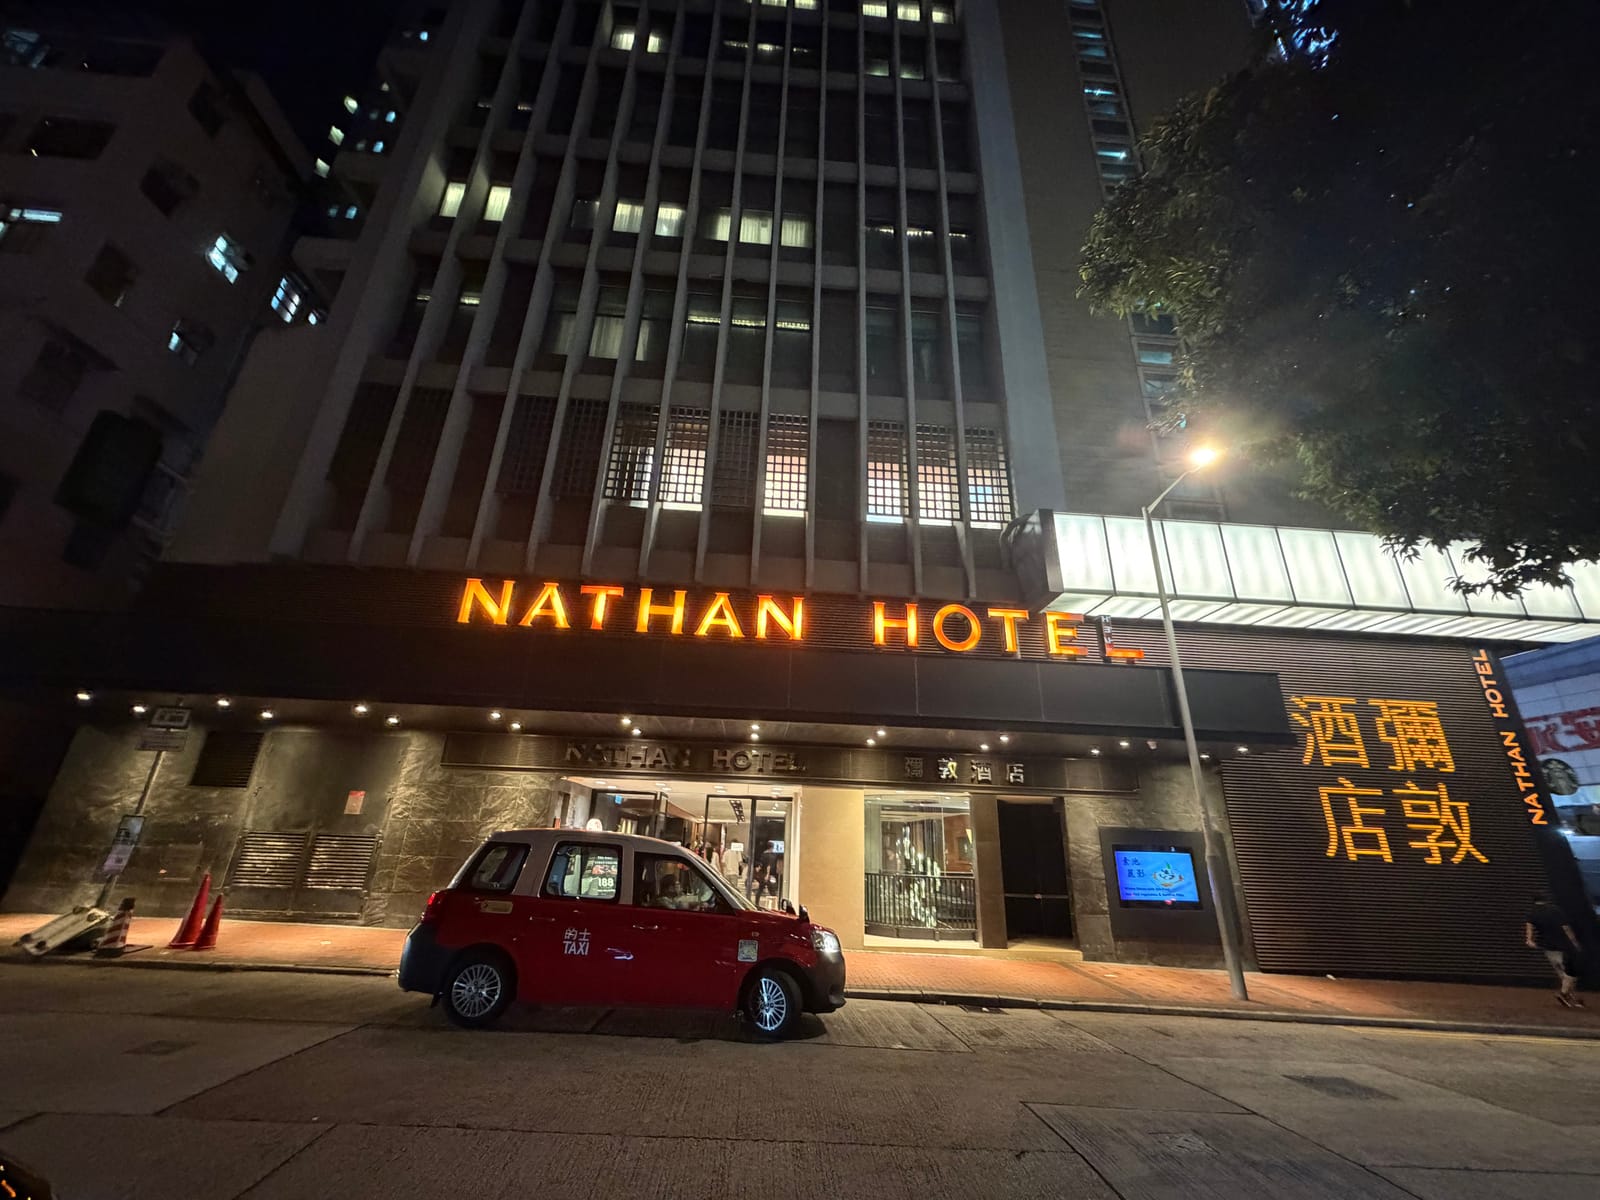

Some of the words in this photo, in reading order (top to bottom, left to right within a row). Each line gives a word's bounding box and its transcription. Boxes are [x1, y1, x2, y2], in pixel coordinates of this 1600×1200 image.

[456, 578, 806, 641] NATHAN
[872, 601, 1145, 659] HOTEL
[1472, 649, 1509, 718] HOTEL
[1500, 731, 1548, 825] NATHAN
[563, 940, 590, 956] TAXI
[564, 928, 592, 941] 的士
